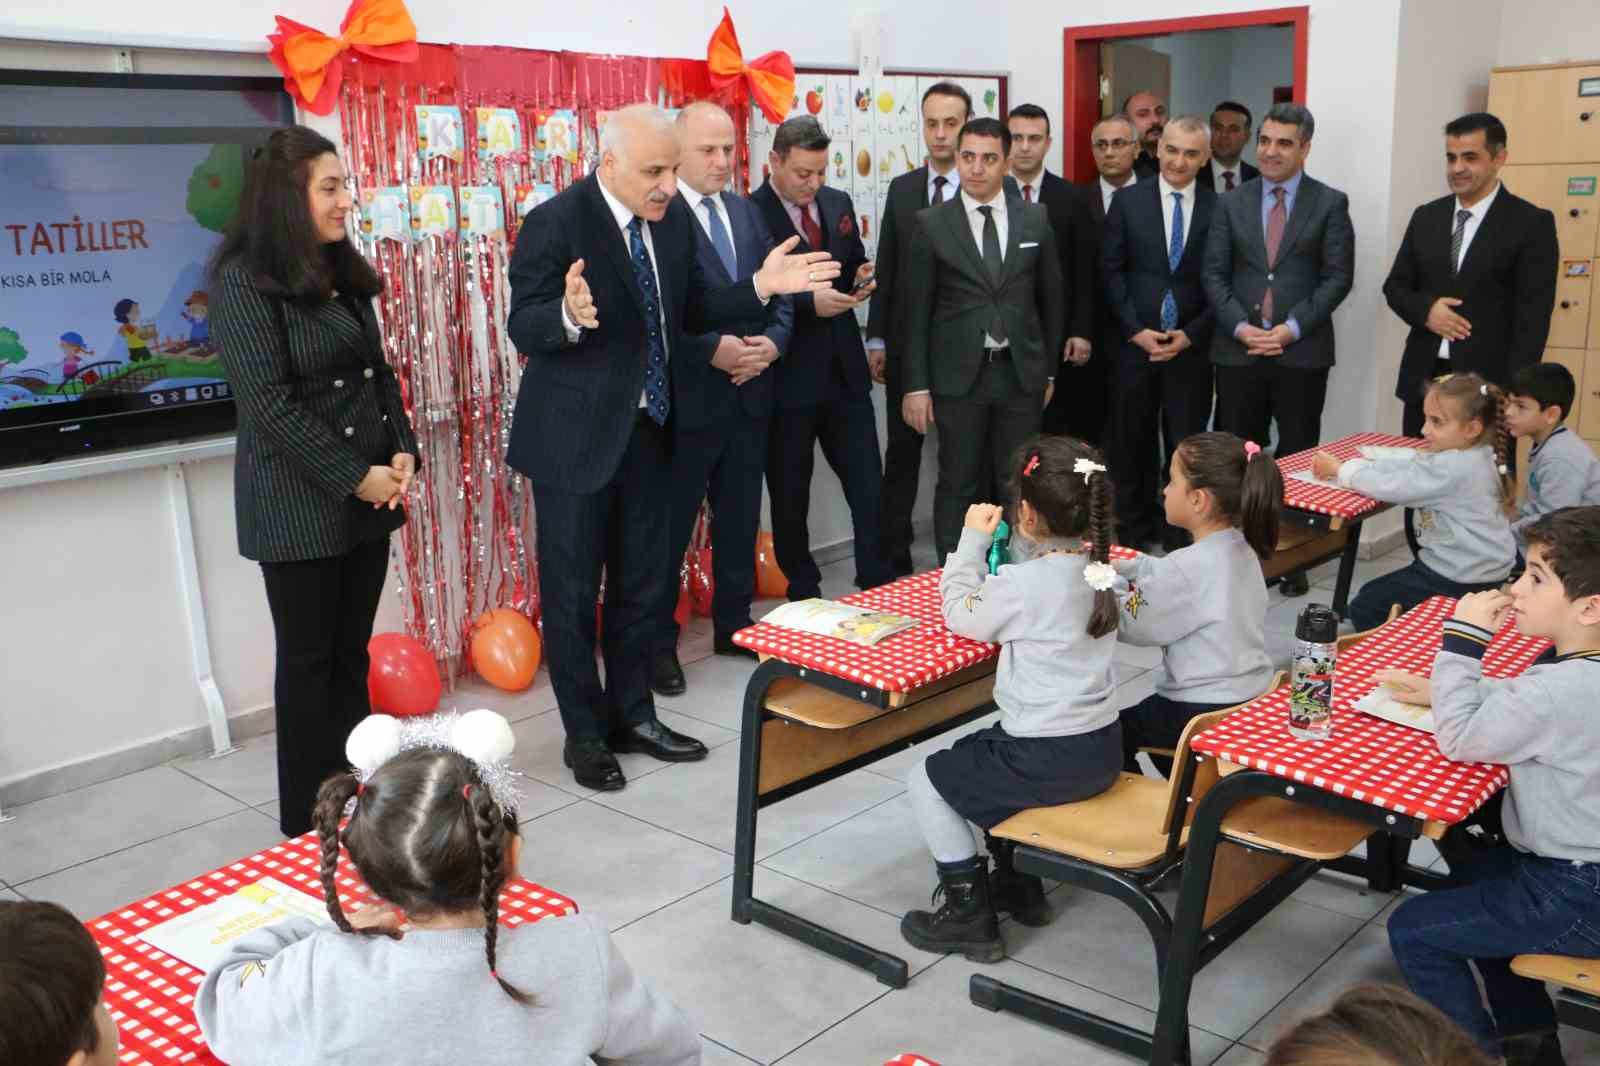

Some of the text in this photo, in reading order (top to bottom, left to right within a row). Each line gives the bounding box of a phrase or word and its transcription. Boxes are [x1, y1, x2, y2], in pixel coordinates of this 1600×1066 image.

[431, 117, 568, 147] KAR
[376, 197, 496, 224] HAT
[4, 214, 150, 256] TATİLLER
[1, 268, 112, 288] KISA BİR MOLA
